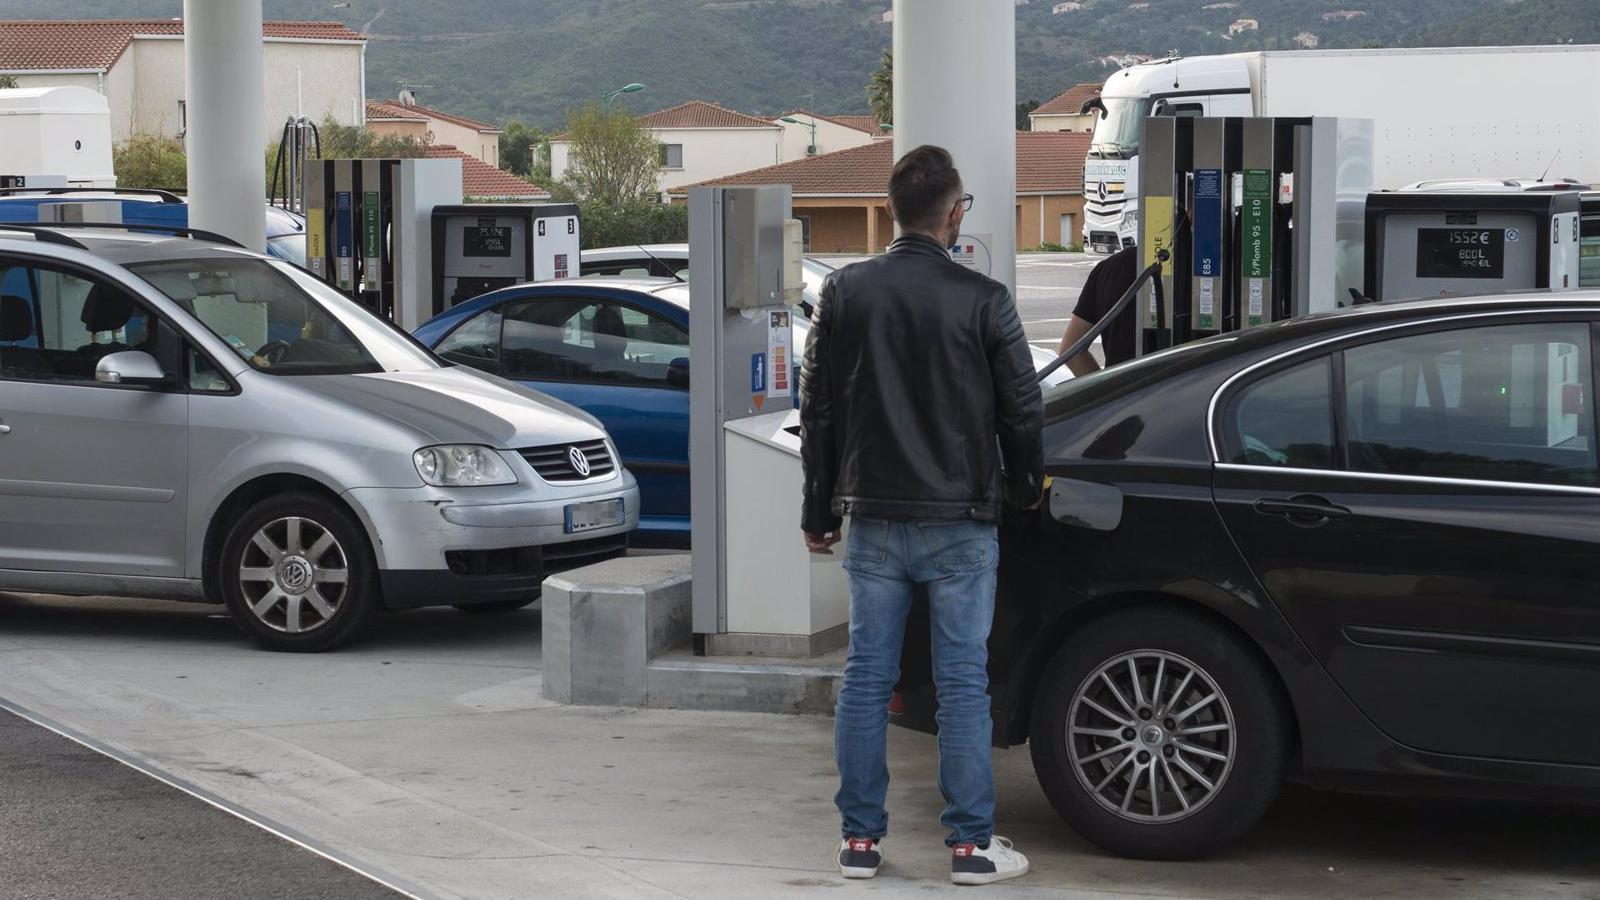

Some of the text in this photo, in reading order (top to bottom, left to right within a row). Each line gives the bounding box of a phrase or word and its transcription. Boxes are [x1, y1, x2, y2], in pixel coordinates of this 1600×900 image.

[1252, 199, 1260, 217] E10
[1252, 225, 1260, 237] 95
[1203, 258, 1211, 275] E85
[1252, 241, 1260, 276] S/Plomb
